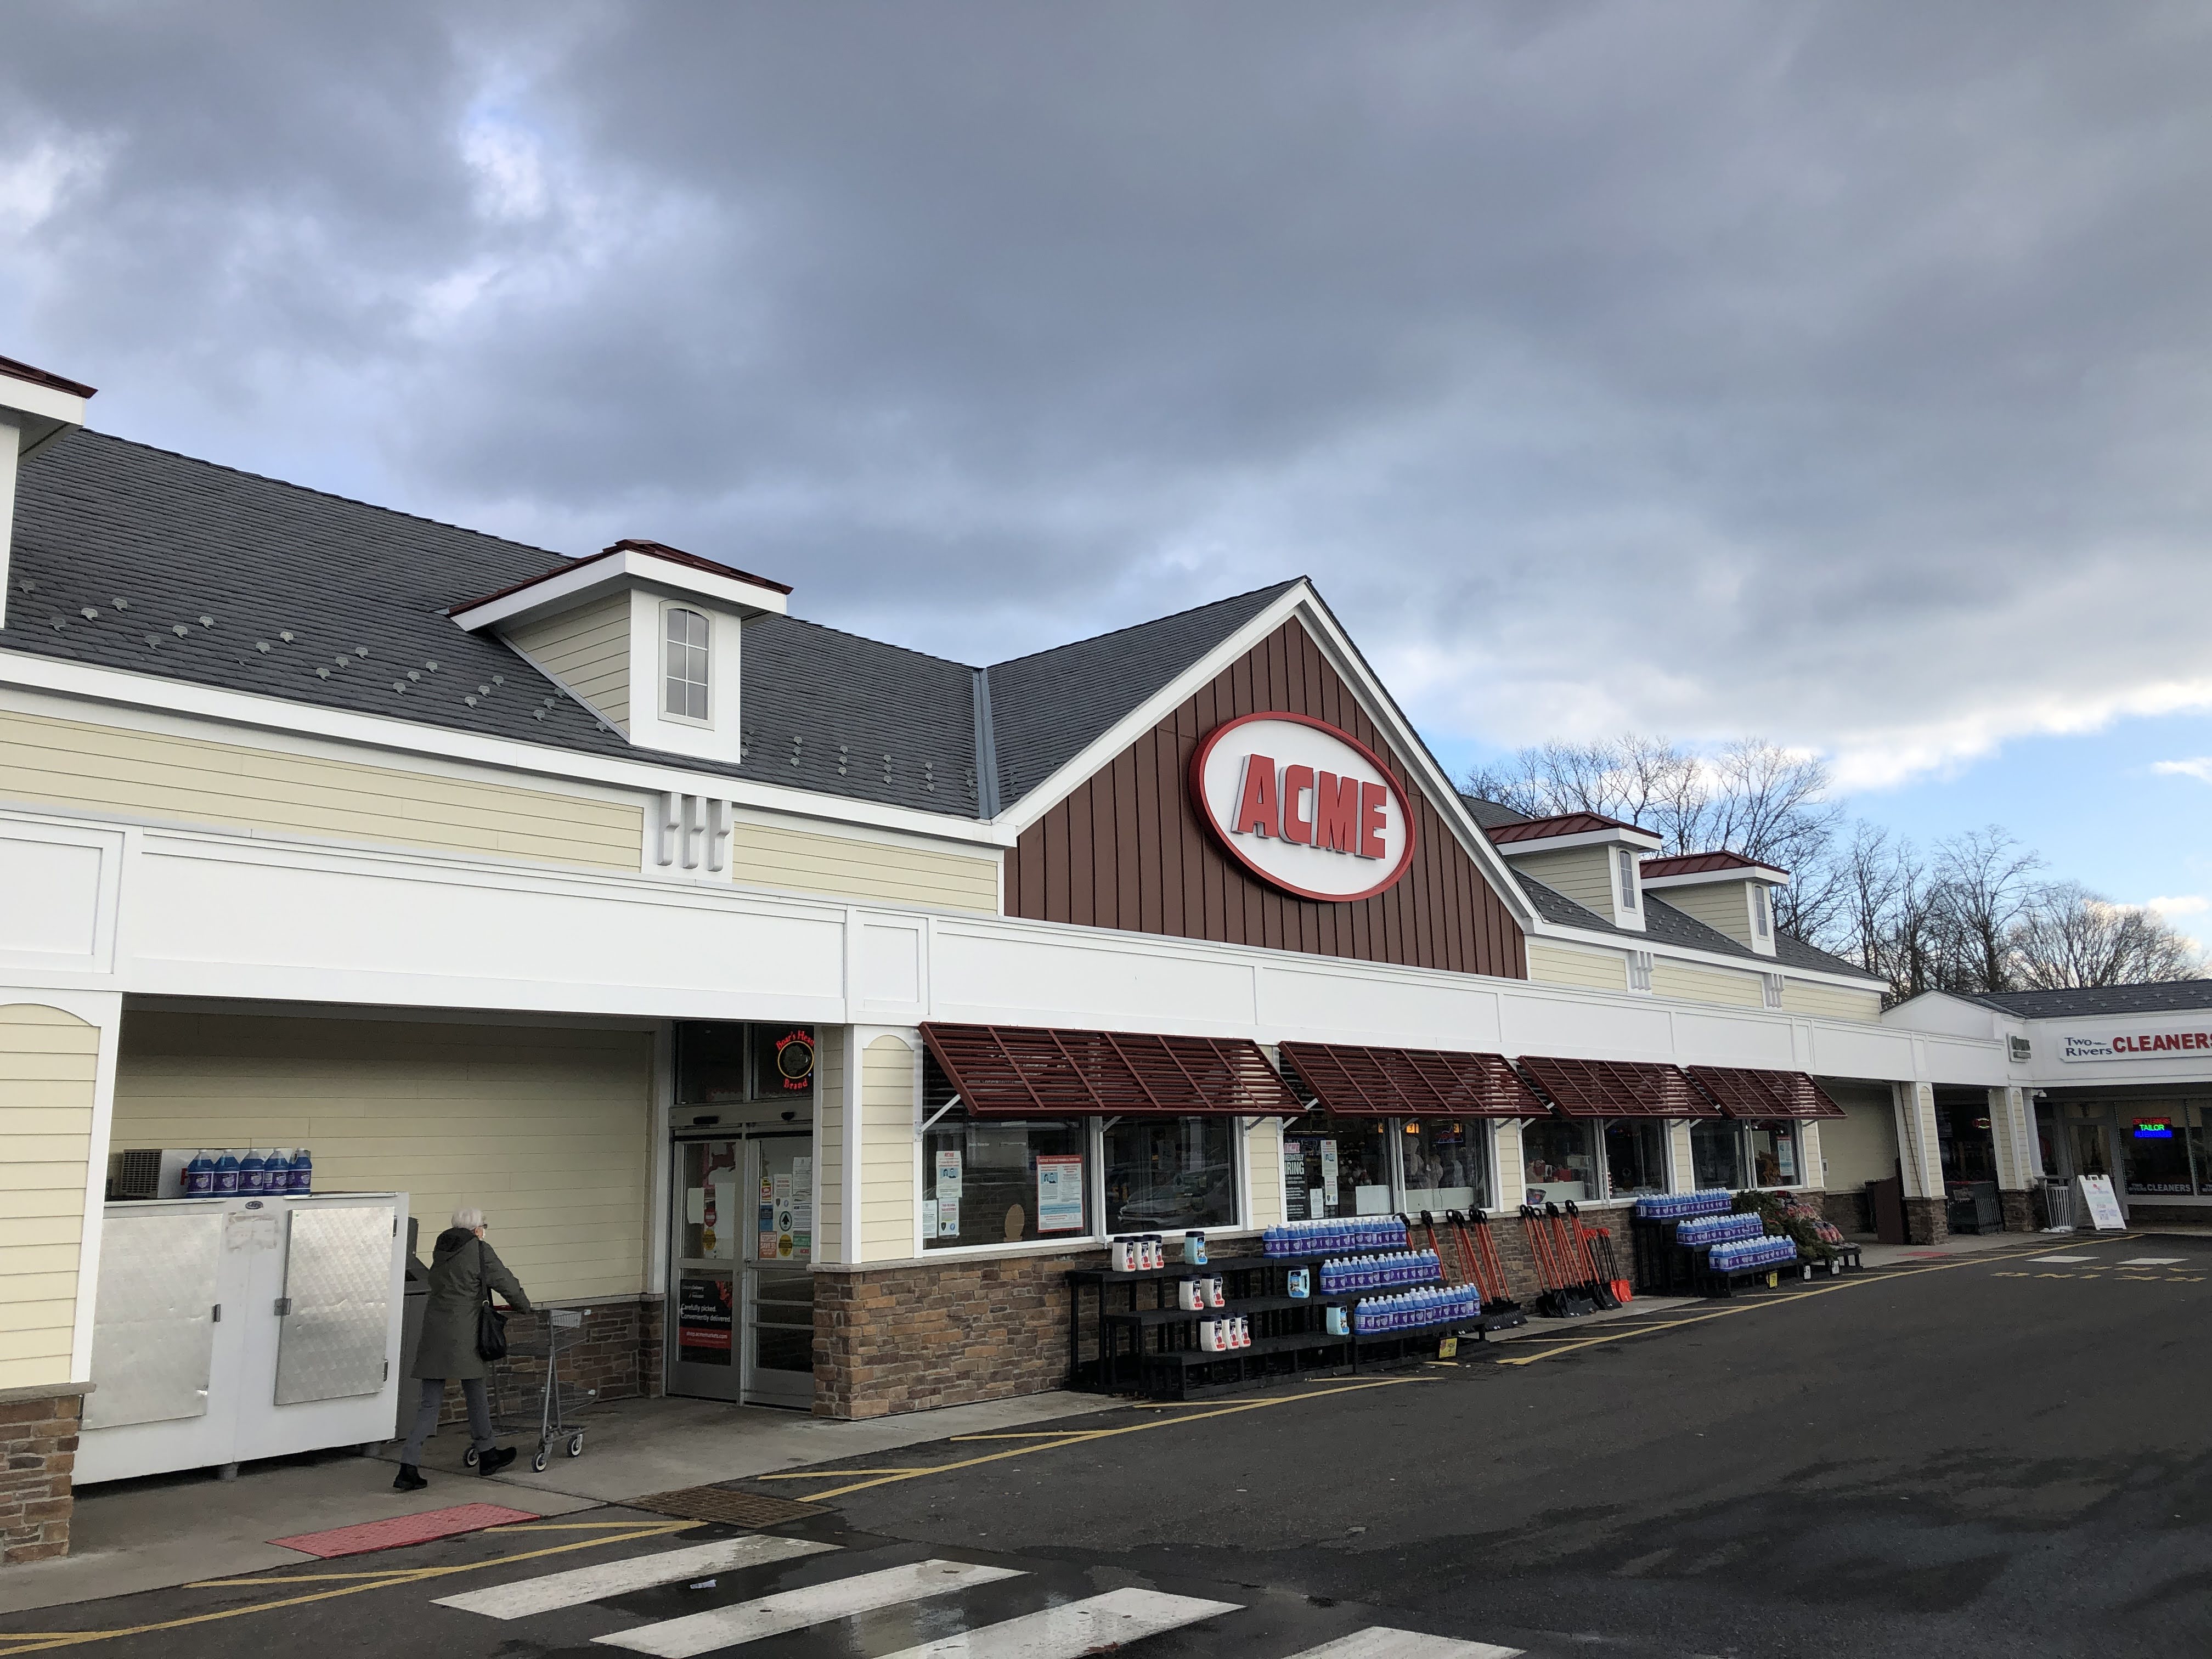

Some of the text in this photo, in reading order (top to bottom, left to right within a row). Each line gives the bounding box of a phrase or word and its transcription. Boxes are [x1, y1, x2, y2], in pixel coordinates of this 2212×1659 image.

[1232, 754, 1387, 859] ACME
[776, 1031, 796, 1050] Boar's
[2064, 1037, 2092, 1046] Two
[2112, 1032, 2212, 1053] CLEANER
[2065, 1047, 2113, 1057] Rivers
[783, 1078, 808, 1090] Brand
[1284, 1161, 1305, 1175] IRING
[2147, 1183, 2191, 1192] CLEANERS
[681, 1304, 701, 1312] Carefully
